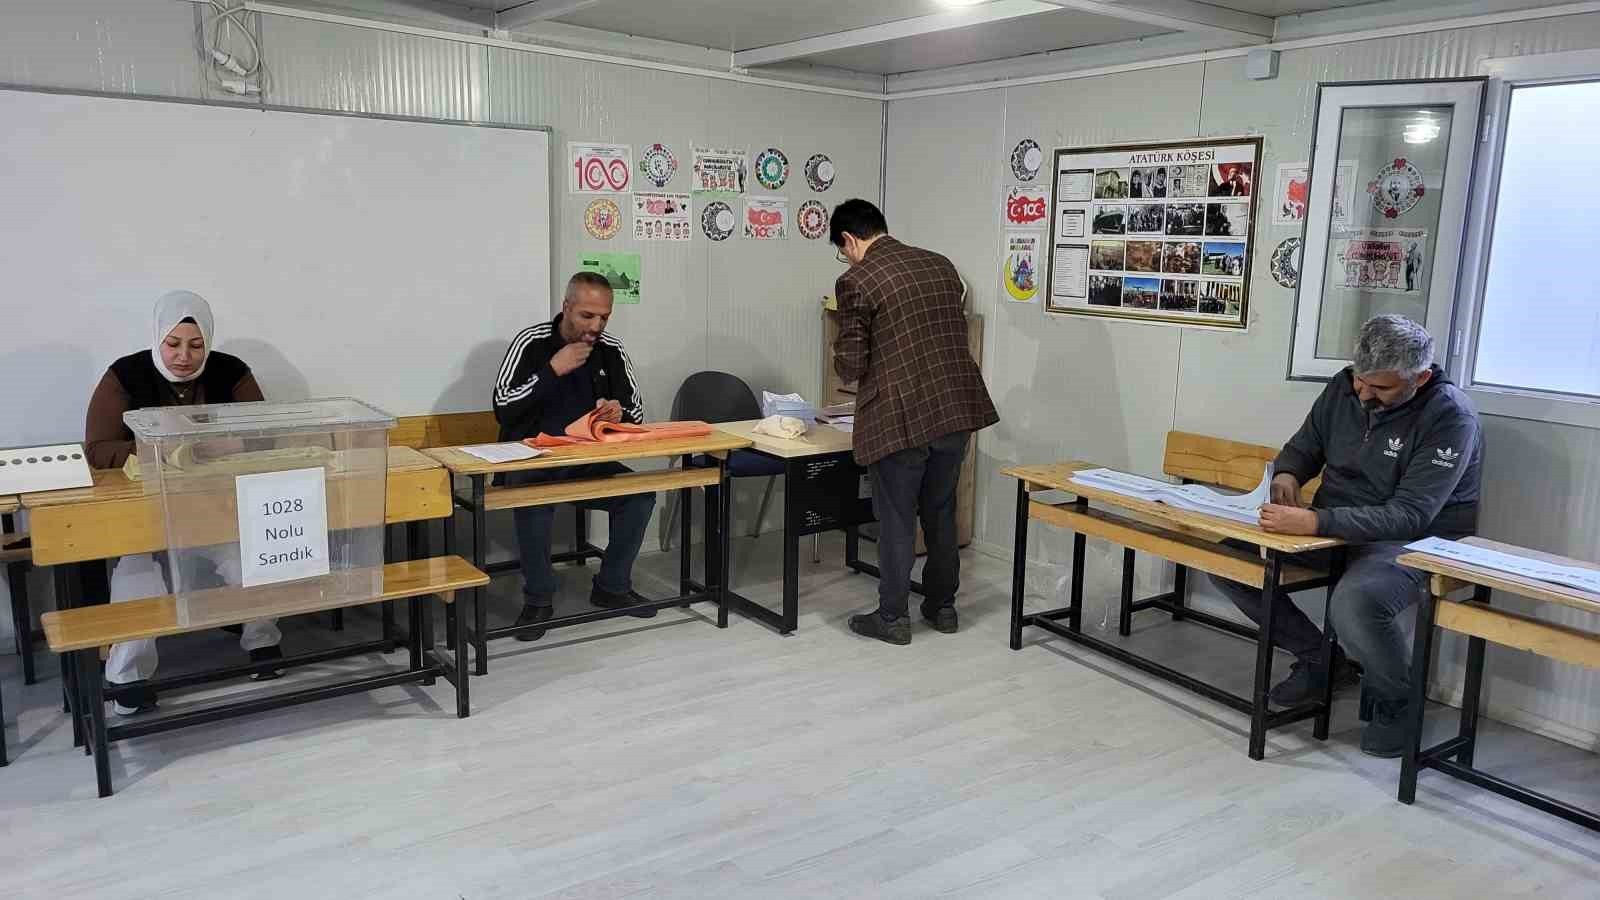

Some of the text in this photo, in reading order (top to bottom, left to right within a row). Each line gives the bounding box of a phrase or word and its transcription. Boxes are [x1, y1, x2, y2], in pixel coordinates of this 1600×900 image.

[1128, 149, 1216, 164] ATATÜRK KÖŞESİ
[263, 498, 304, 516] 1028
[265, 524, 303, 541] Nolu
[258, 546, 313, 567] Sandık
